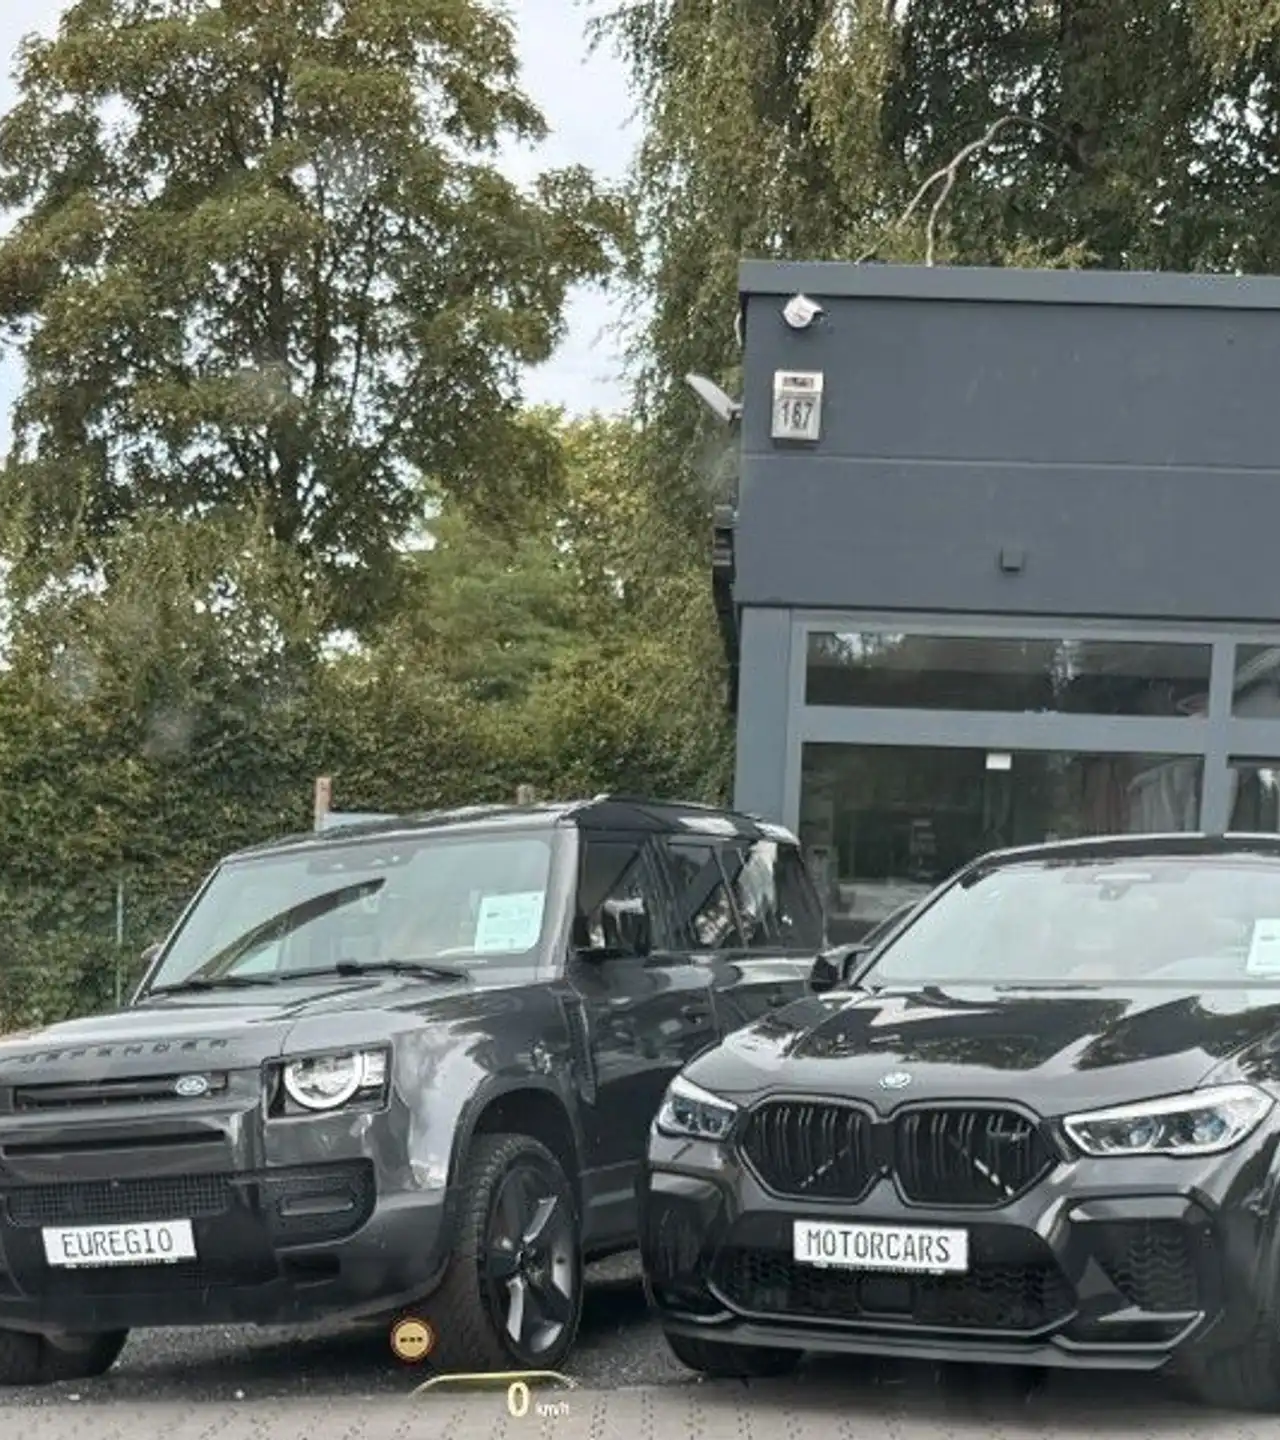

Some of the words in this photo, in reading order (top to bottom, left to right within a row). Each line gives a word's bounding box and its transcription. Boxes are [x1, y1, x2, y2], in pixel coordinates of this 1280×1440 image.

[61, 1228, 173, 1259] EUREGIO
[806, 1229, 951, 1263] MOTORCARS
[508, 1382, 529, 1417] 0
